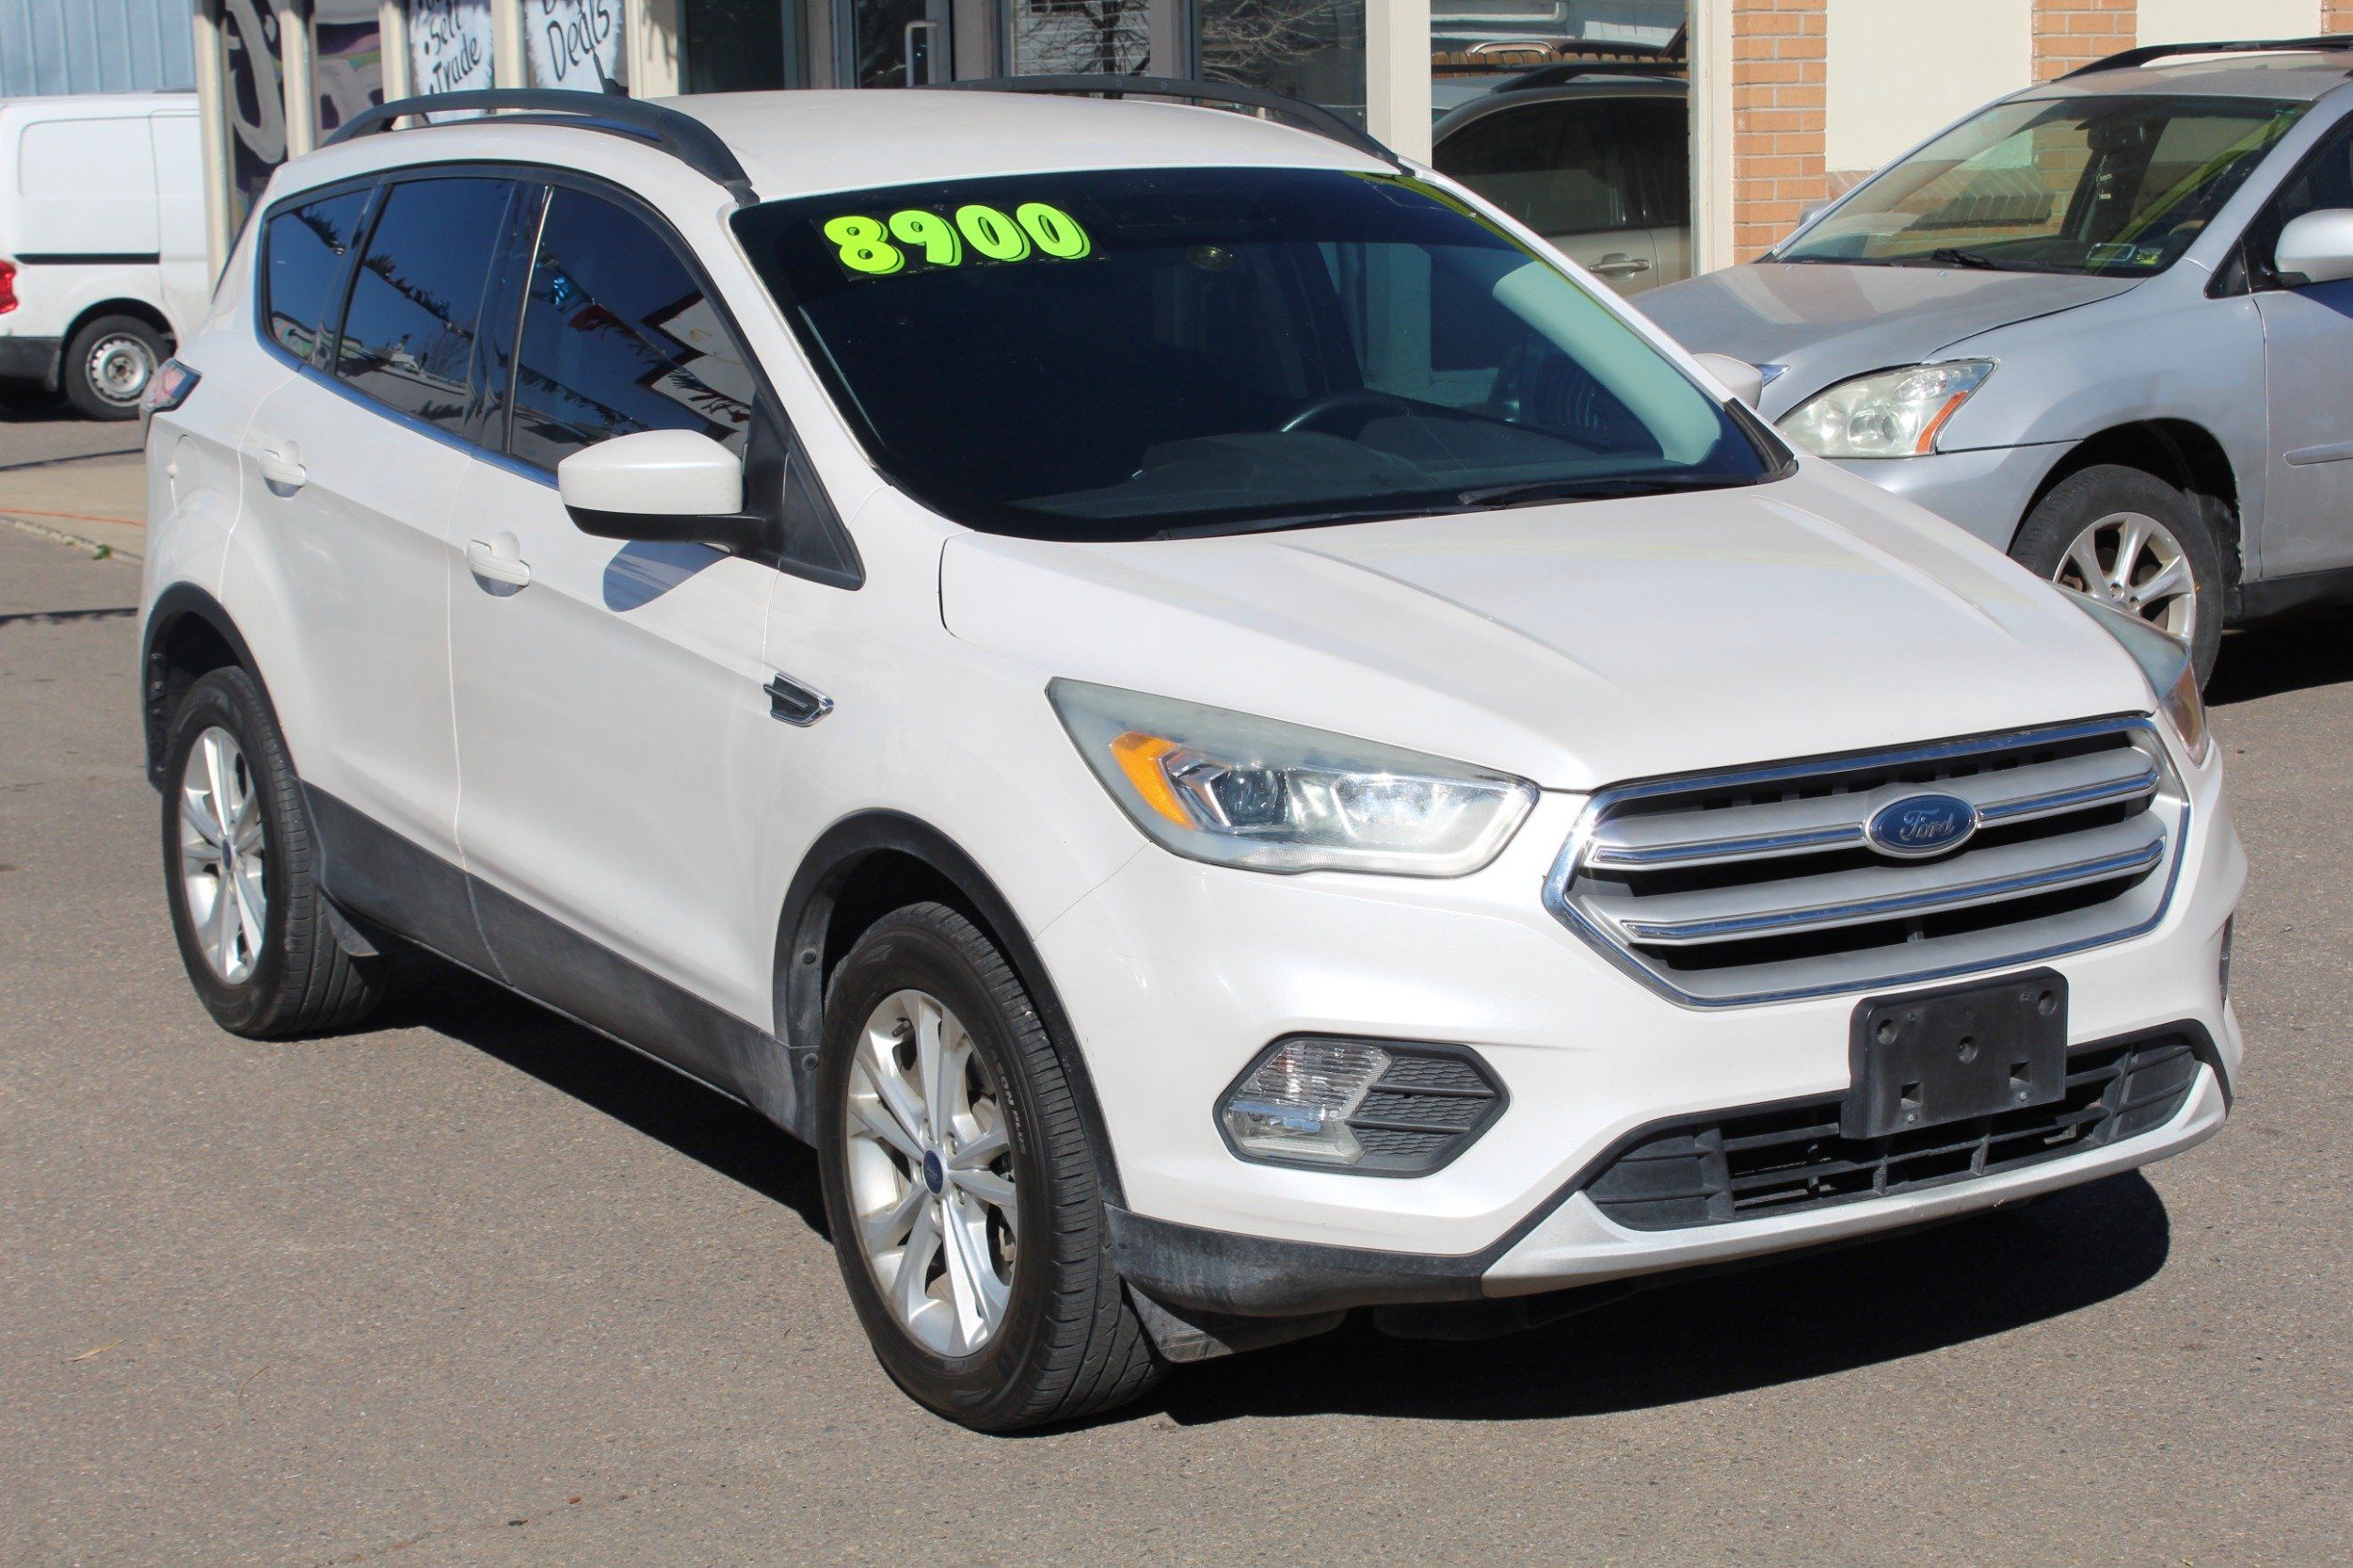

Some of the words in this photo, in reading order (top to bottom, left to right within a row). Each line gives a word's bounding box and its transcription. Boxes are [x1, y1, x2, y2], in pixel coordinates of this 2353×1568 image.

[432, 34, 481, 94] Trade
[547, 0, 611, 82] Deals
[824, 202, 1091, 275] 8900
[1899, 808, 1957, 841] Ford
